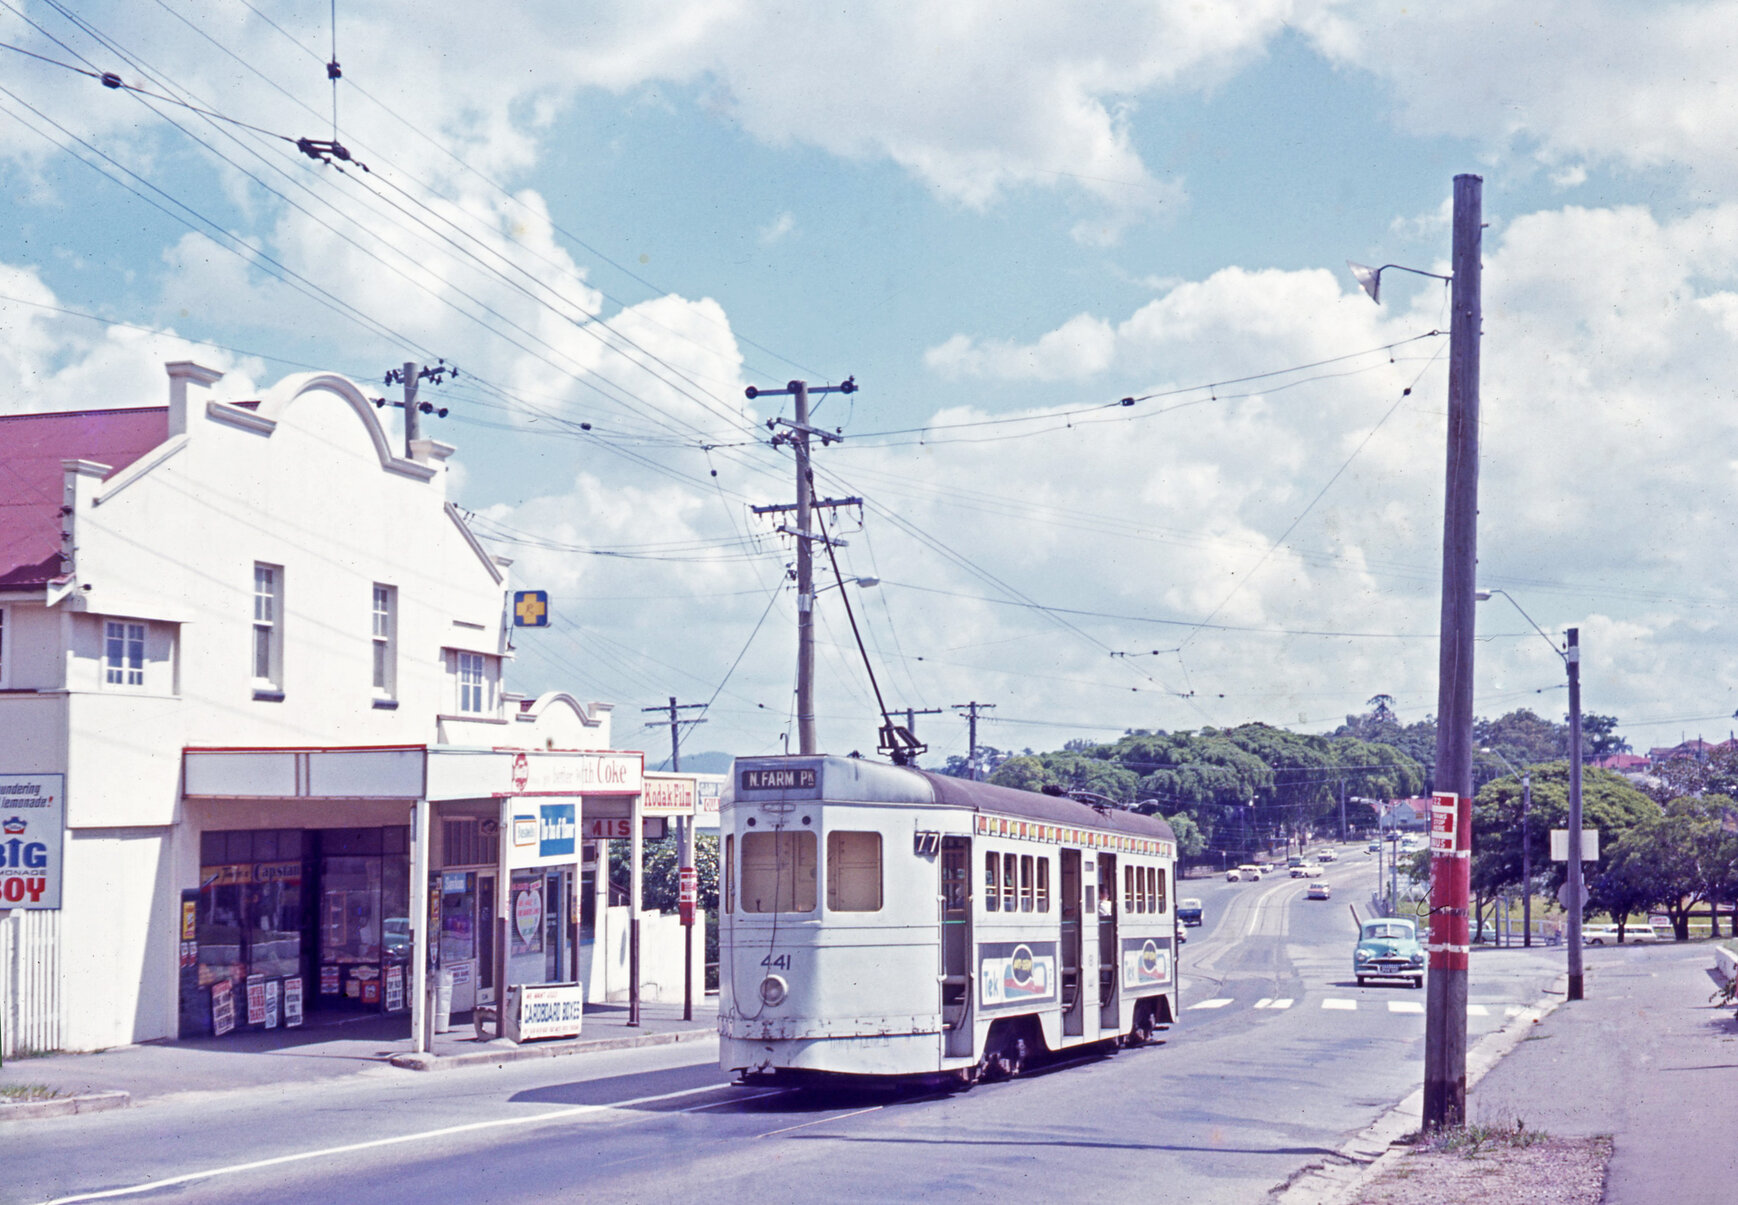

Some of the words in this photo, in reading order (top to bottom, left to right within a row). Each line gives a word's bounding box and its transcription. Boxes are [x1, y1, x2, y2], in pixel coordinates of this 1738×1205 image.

[597, 756, 626, 783] Coke
[749, 772, 760, 787] N.
[761, 771, 794, 787] FARM
[643, 782, 673, 807] Kodak
[674, 783, 692, 807] Film
[0, 838, 47, 868] IG
[915, 833, 938, 853] 77
[0, 877, 46, 902] OY
[760, 954, 791, 970] 441
[983, 970, 999, 998] Tek
[525, 1003, 561, 1024] CARDBOARD
[562, 1001, 580, 1021] BOXES
